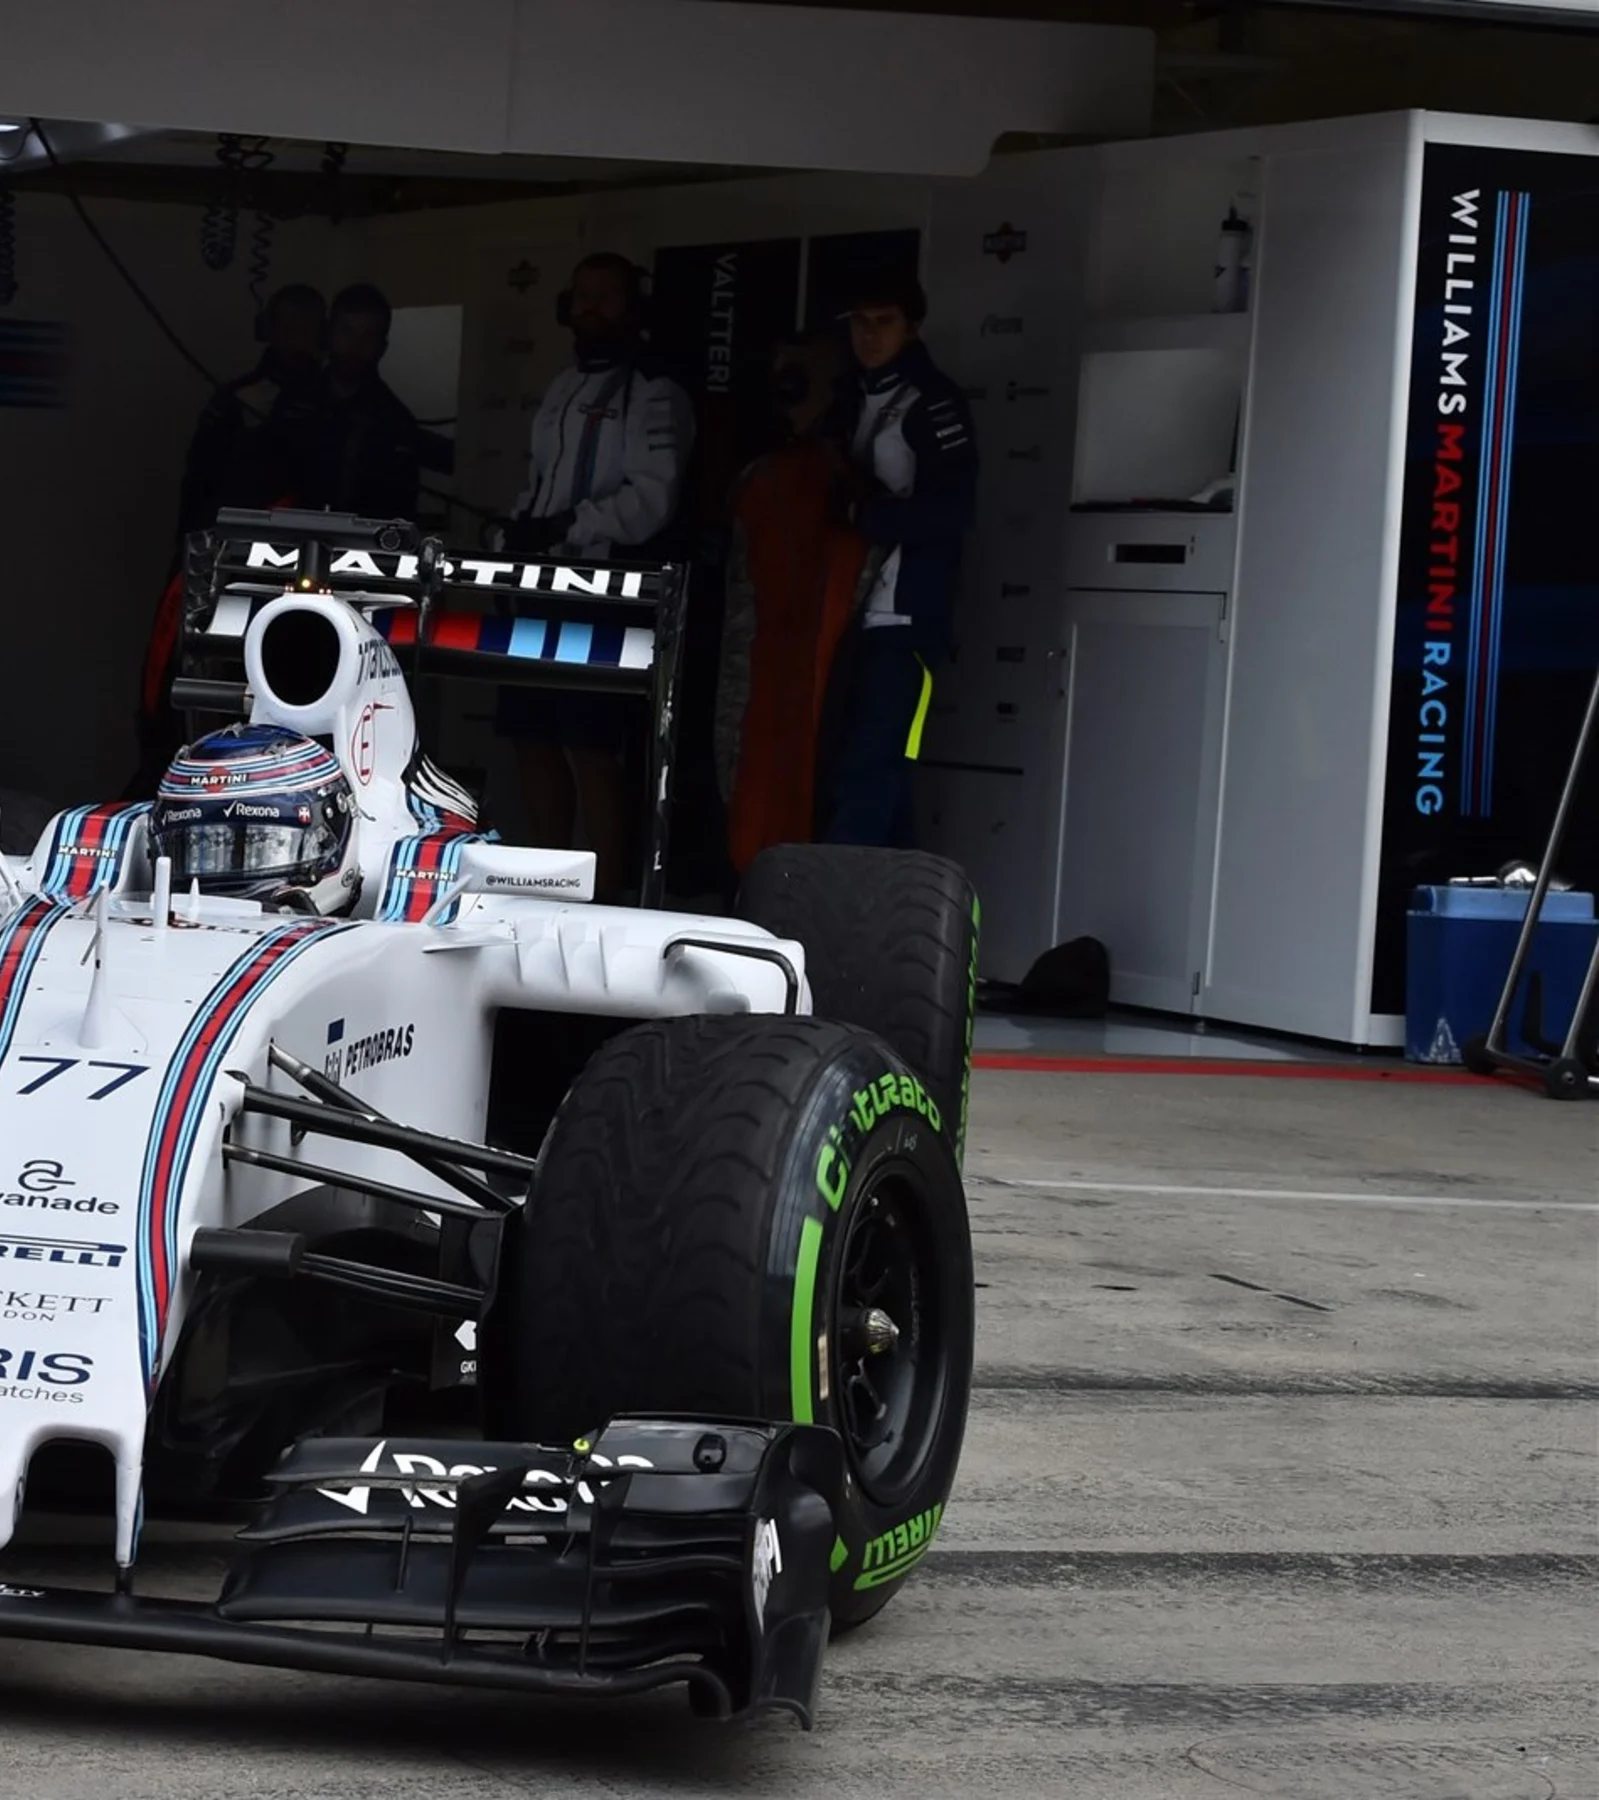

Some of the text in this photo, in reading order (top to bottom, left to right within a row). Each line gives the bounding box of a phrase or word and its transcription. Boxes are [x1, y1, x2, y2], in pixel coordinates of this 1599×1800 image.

[705, 252, 738, 392] VALTTERI
[1415, 189, 1481, 816] WILLIAMS MARTINI RACING
[191, 773, 249, 786] MARTINI
[166, 807, 202, 823] Rexona
[236, 802, 280, 818] Rexona
[58, 846, 116, 859] MARTINI
[396, 868, 455, 882] MARTINI
[485, 874, 581, 889] @WILLIAMSRACING
[344, 1023, 415, 1078] PETROBRAS
[16, 1055, 152, 1101] 77
[853, 1502, 943, 1591] PIRELLI
